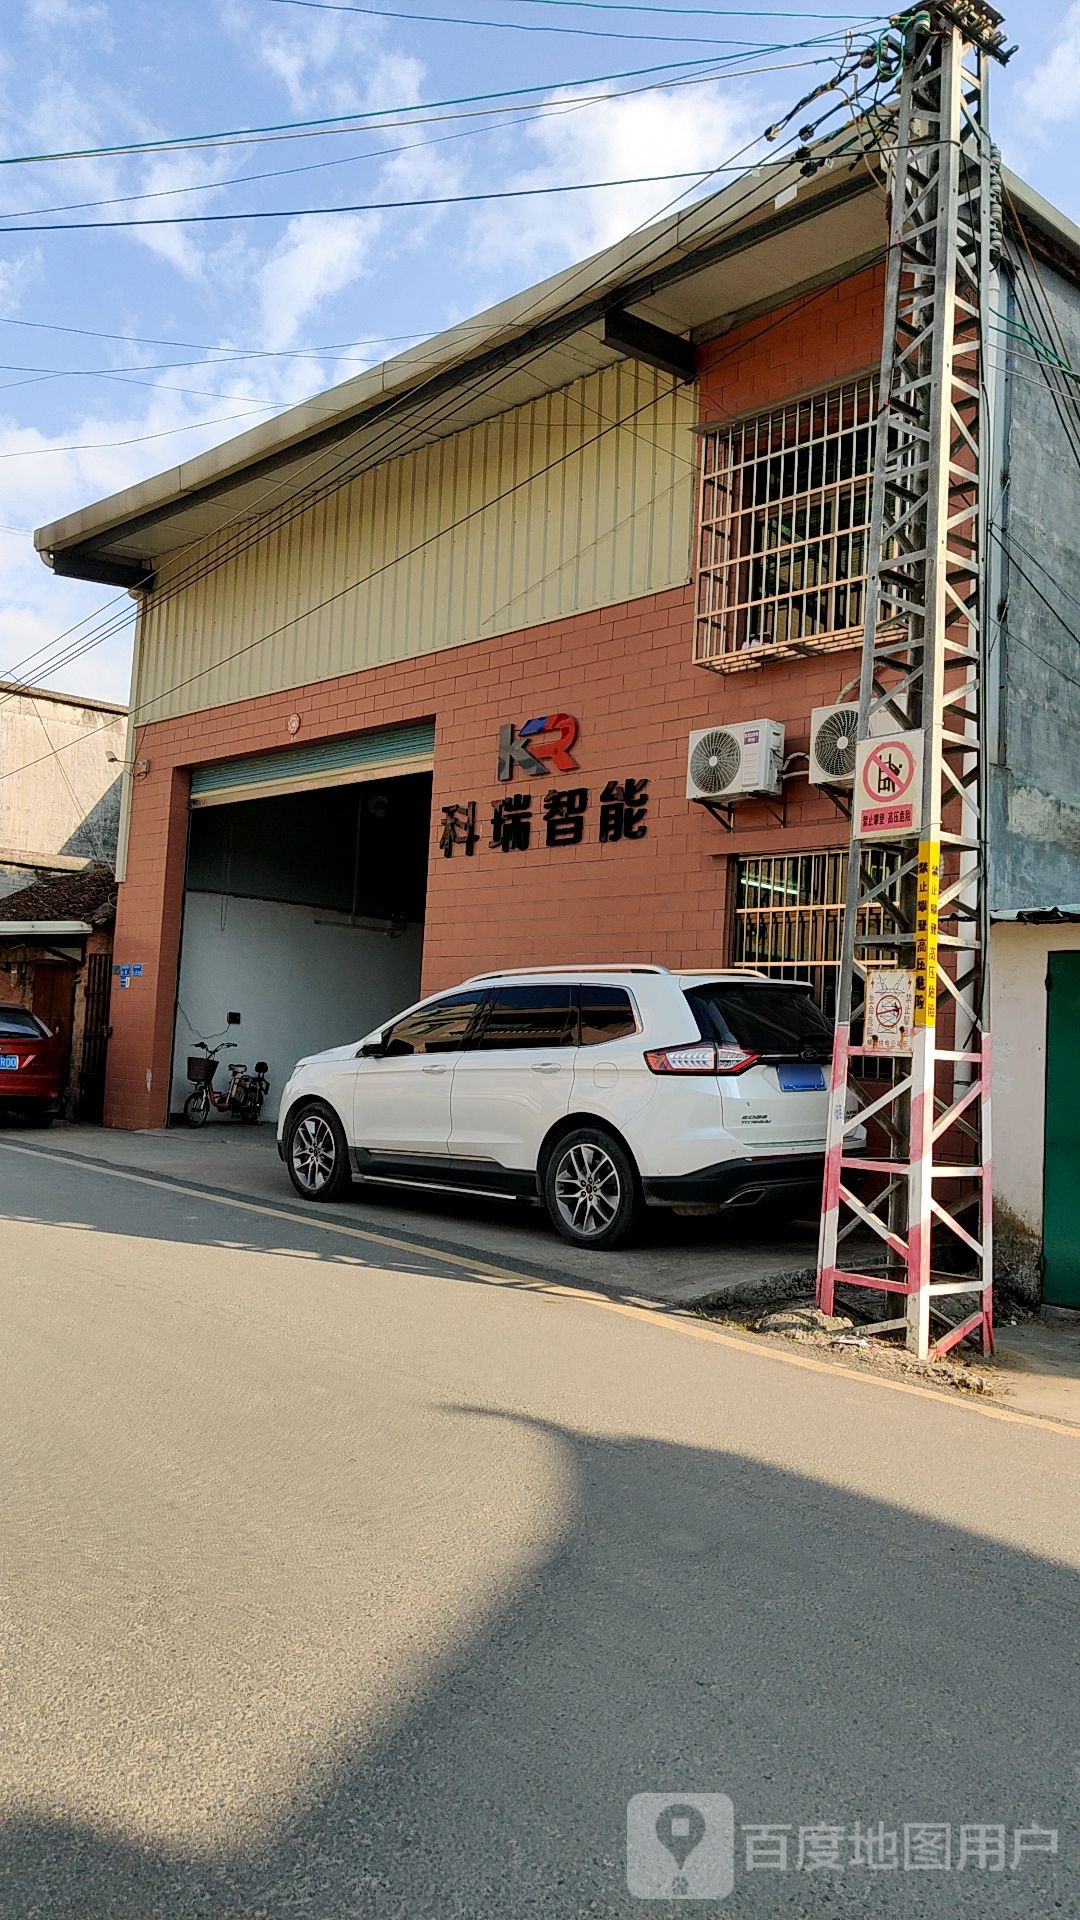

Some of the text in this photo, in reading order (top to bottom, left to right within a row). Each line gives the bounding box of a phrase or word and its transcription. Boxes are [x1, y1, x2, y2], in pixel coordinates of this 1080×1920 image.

[498, 712, 580, 782] KR
[439, 778, 650, 859] 科瑞智能
[862, 809, 912, 827] 禁止攀登 高压危险
